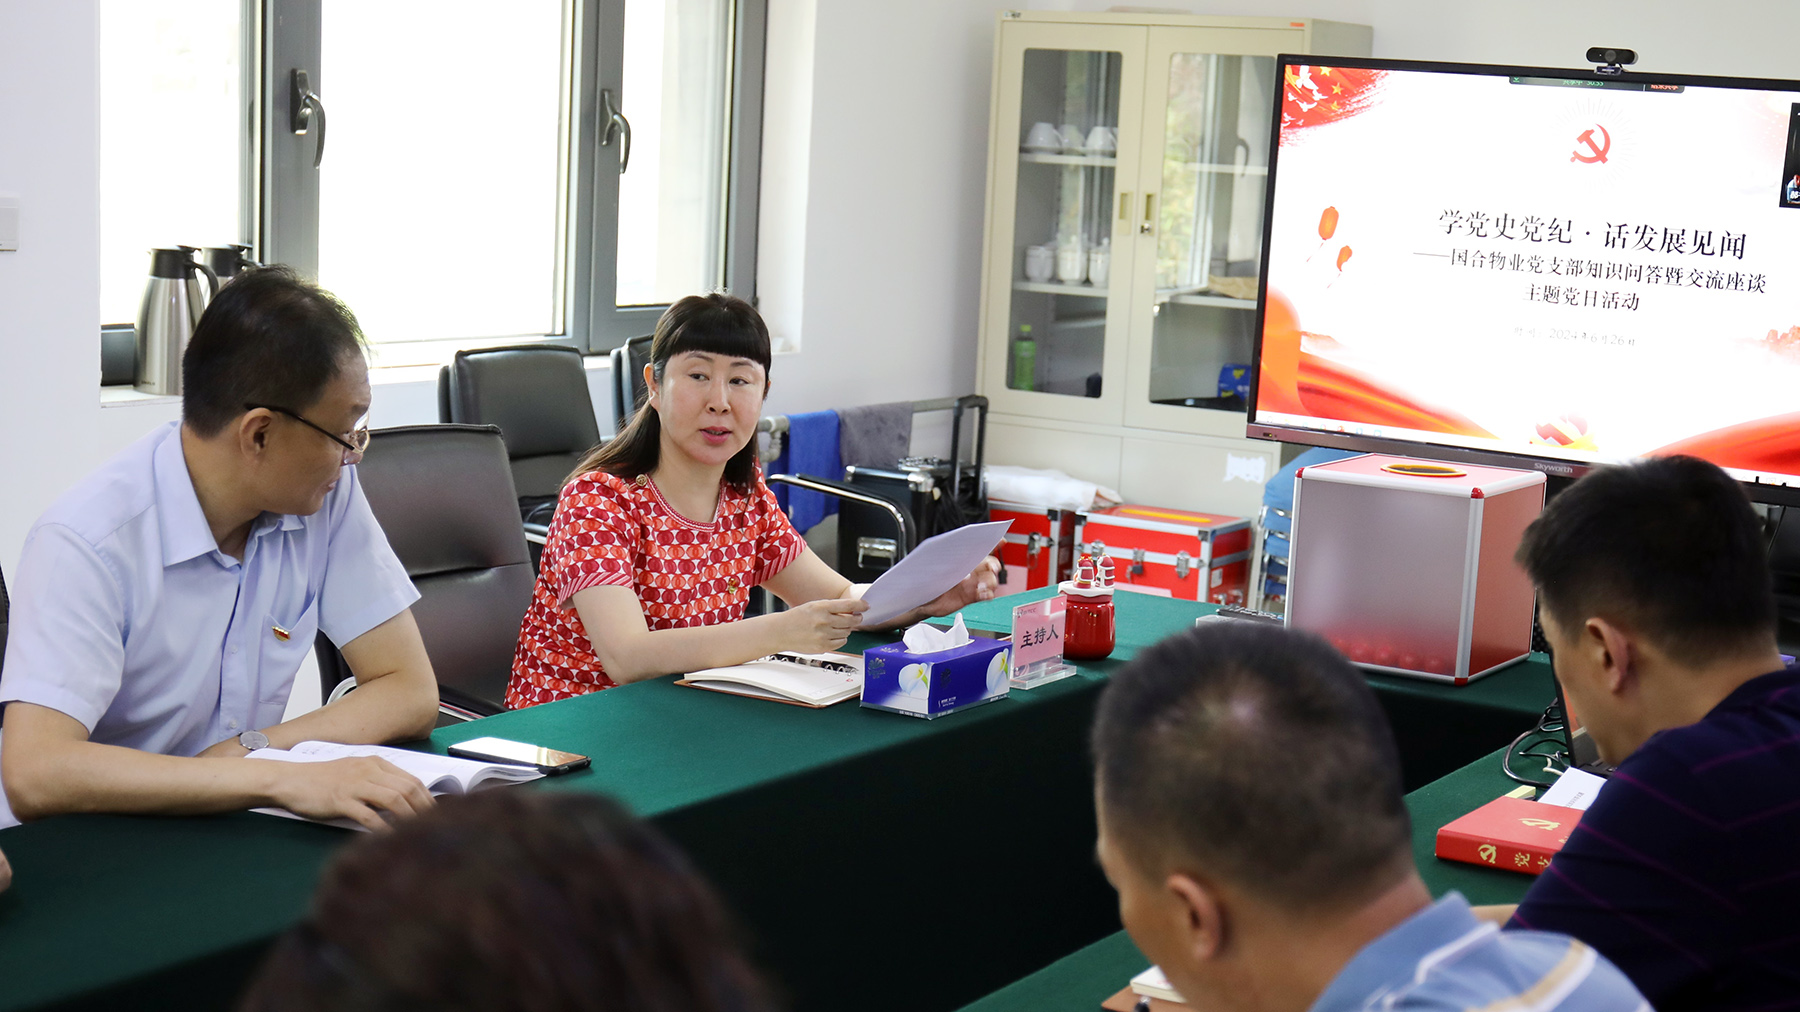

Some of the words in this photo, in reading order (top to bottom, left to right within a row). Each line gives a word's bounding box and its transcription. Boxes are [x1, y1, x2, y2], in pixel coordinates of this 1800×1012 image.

[1525, 283, 1641, 312] 主题党日活动
[1534, 462, 1574, 474] Skyworth
[1020, 624, 1059, 649] 主持人
